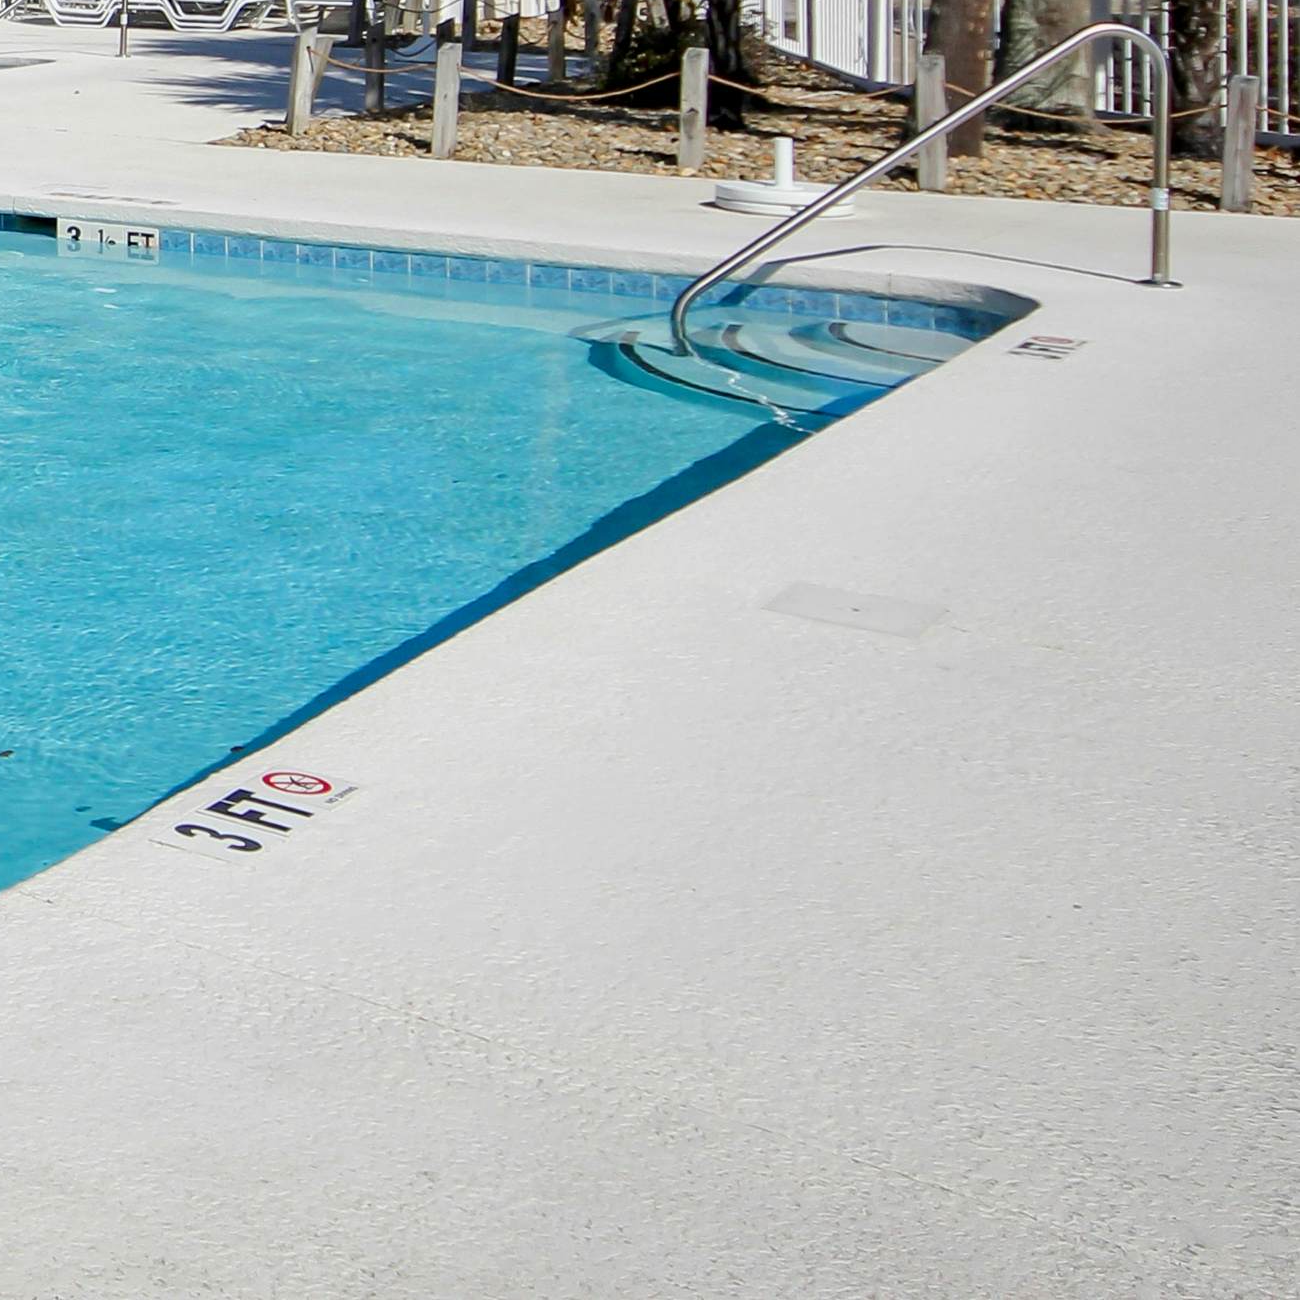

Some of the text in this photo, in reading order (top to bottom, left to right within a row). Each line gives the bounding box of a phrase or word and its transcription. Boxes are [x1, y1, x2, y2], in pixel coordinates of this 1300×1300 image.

[128, 232, 155, 250] FT
[174, 788, 315, 853] 3 FT
